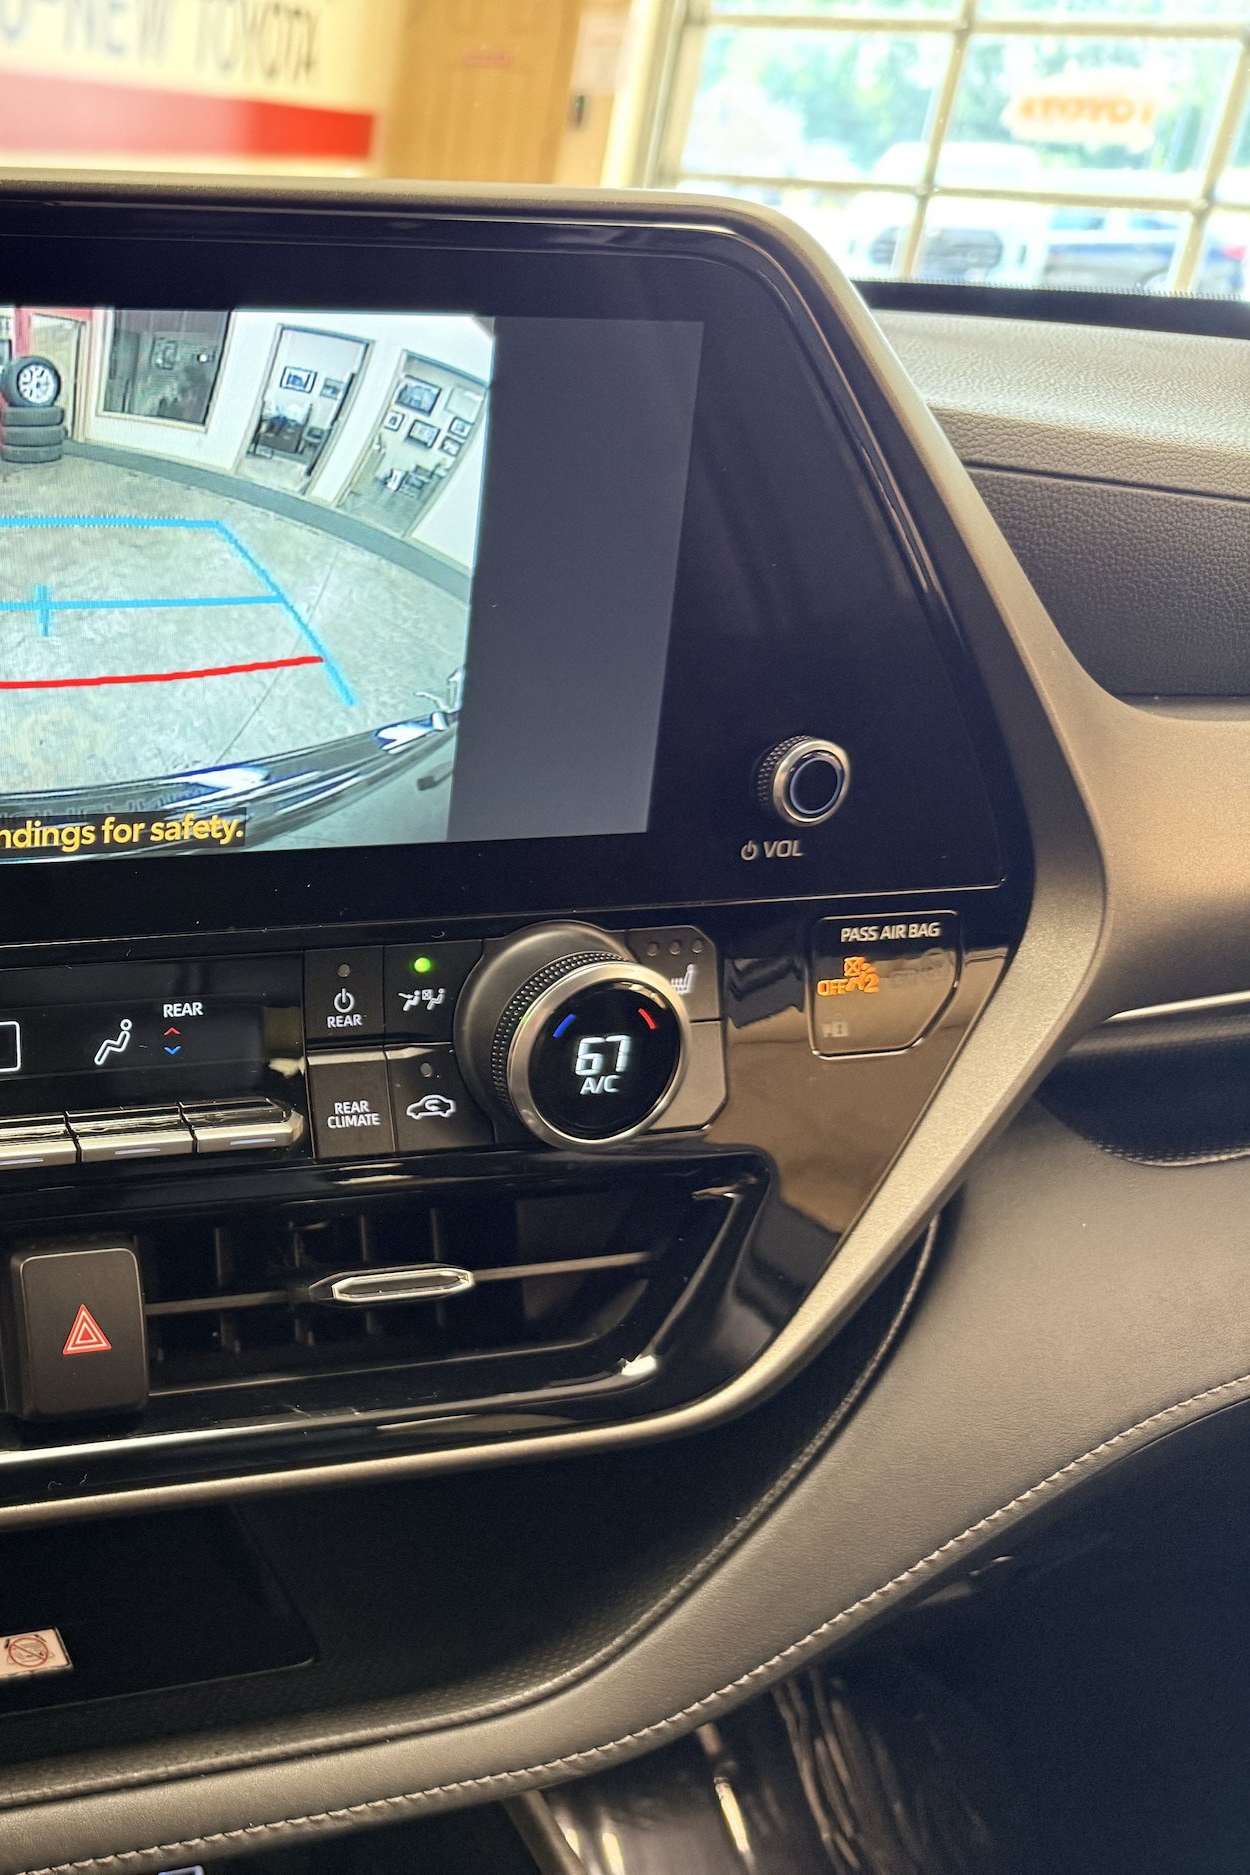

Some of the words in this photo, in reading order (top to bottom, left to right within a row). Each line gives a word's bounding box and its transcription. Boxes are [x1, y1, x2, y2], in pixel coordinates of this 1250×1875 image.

[101, 816, 145, 843] for
[150, 813, 245, 846] safety.
[763, 840, 803, 858] VOL
[840, 925, 879, 942] PASS
[879, 923, 907, 940] AIR
[908, 921, 942, 938] BAG
[816, 978, 847, 996] OFF
[162, 1001, 204, 1018] REAR
[327, 1014, 362, 1028] REAR
[575, 1034, 631, 1076] 67
[579, 1074, 620, 1095] A/C
[334, 1100, 369, 1115] REAR
[327, 1112, 381, 1129] CLIMATE
